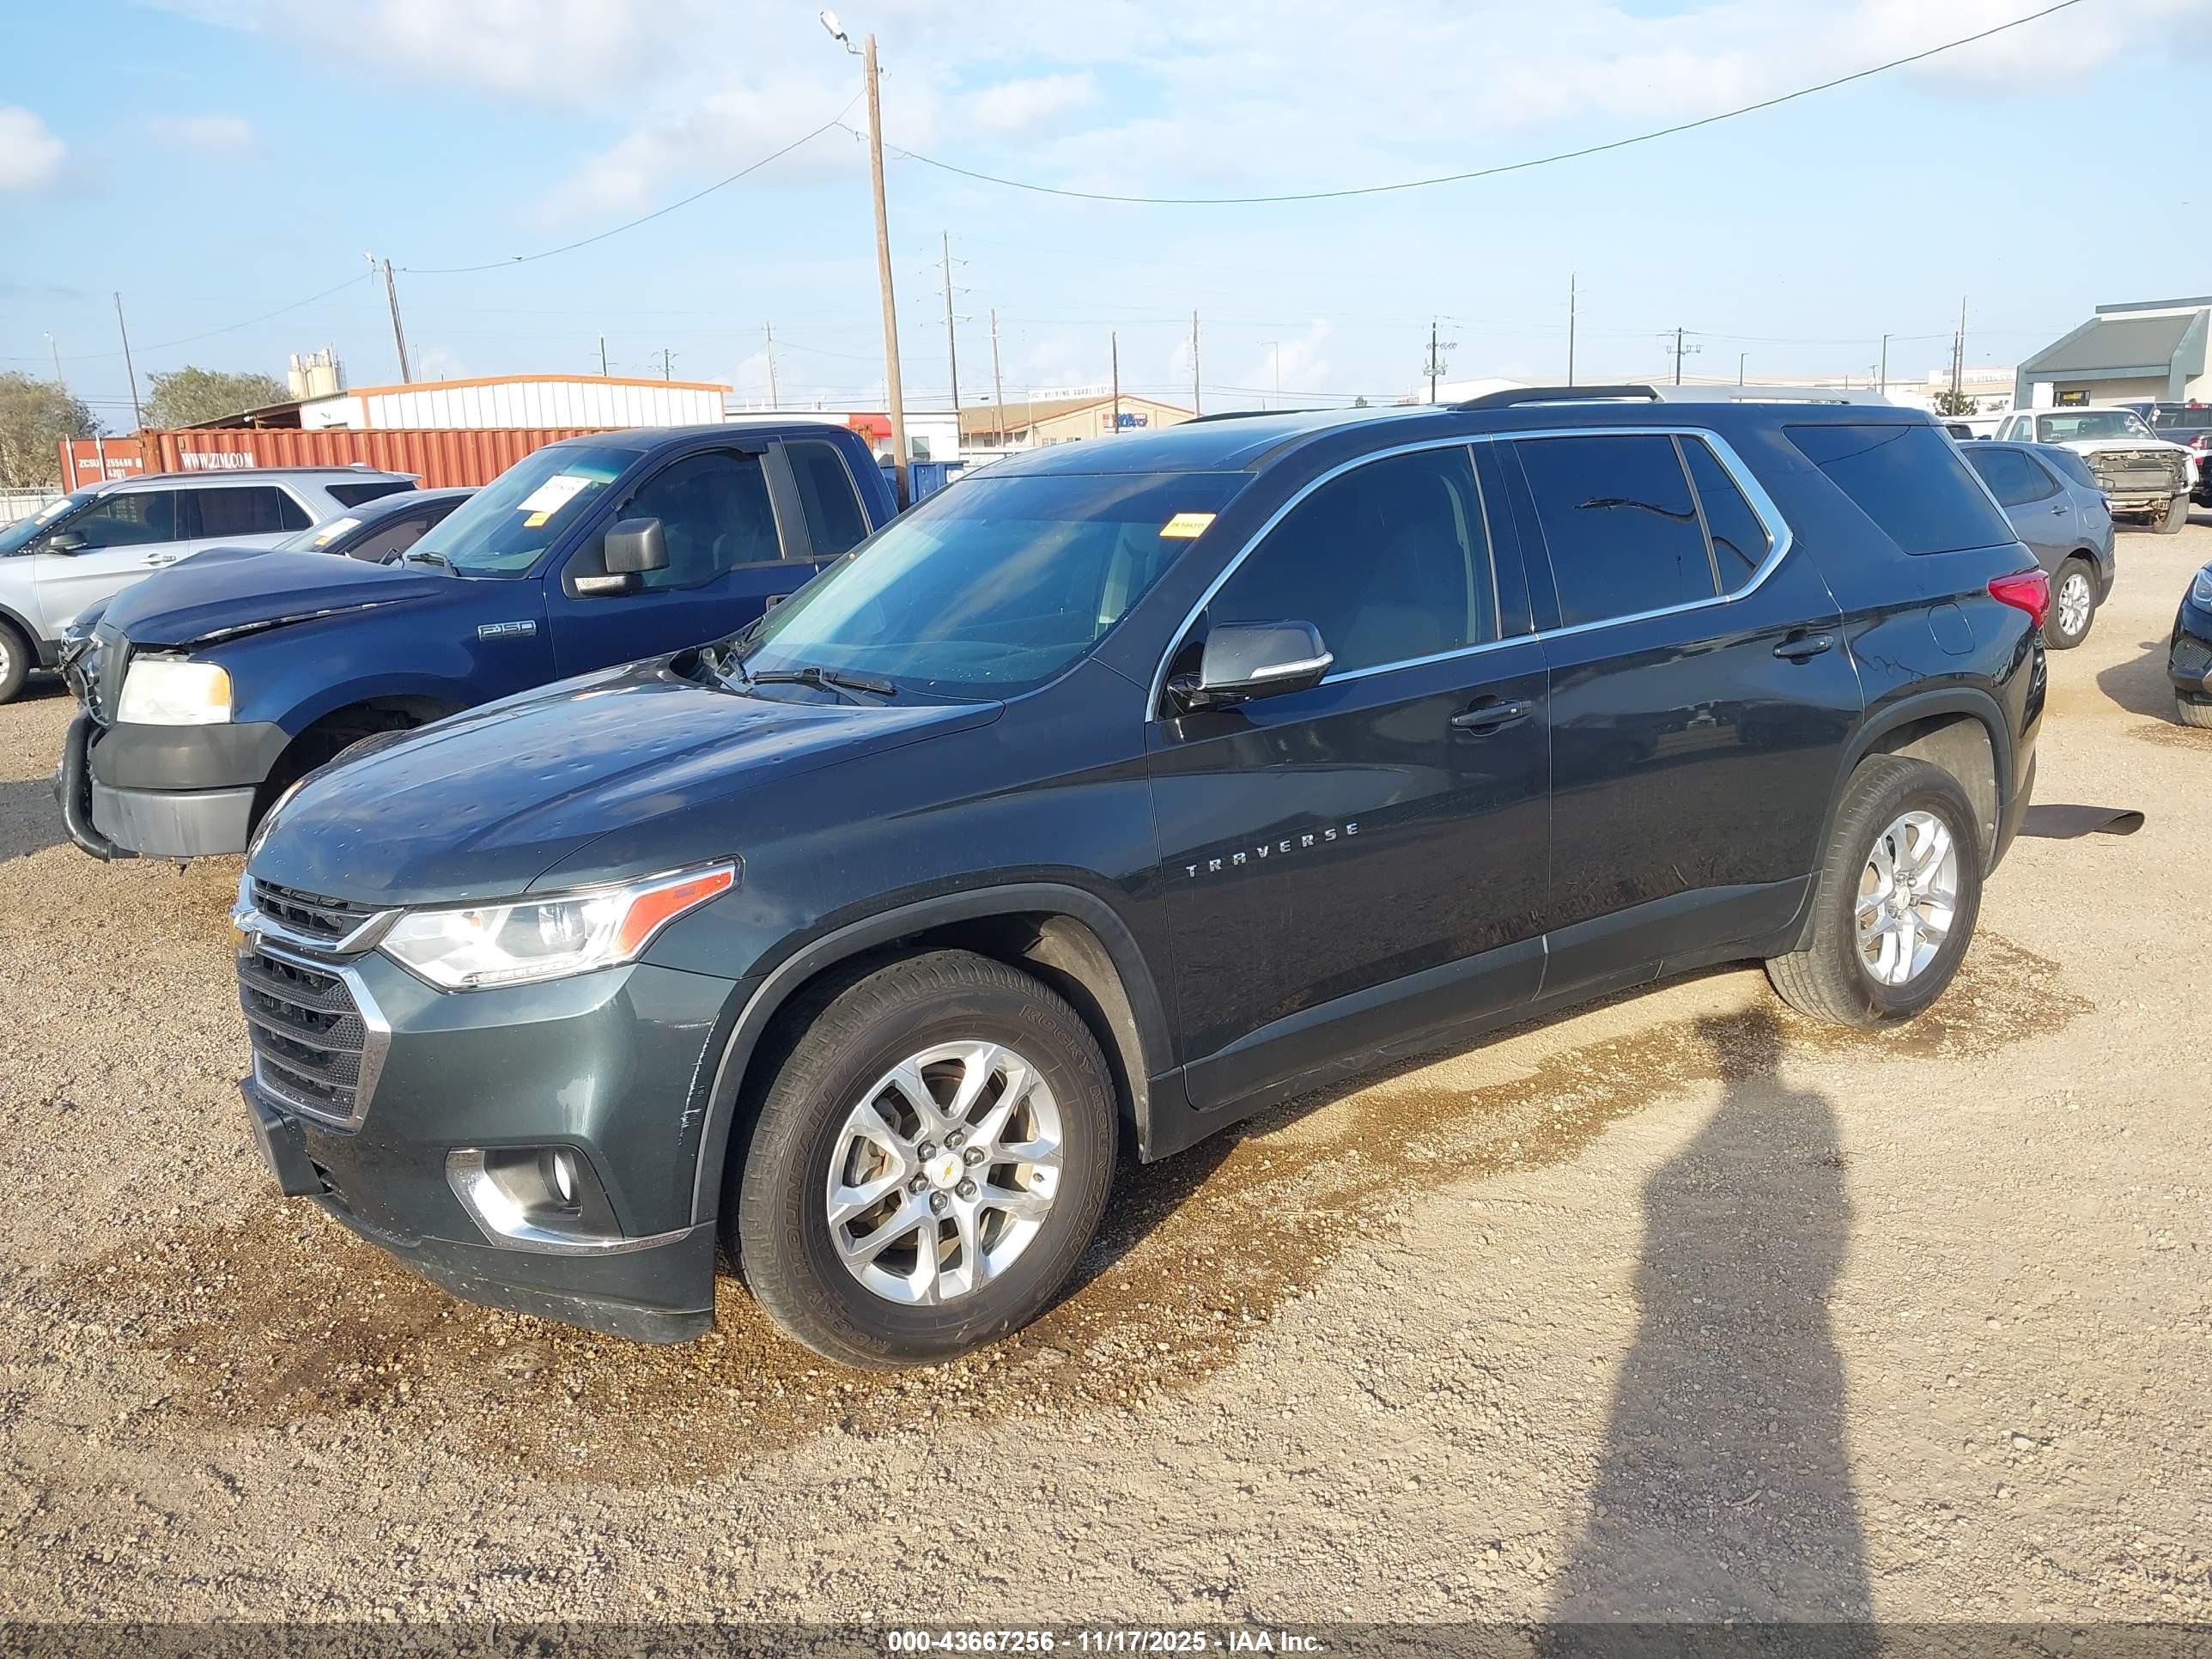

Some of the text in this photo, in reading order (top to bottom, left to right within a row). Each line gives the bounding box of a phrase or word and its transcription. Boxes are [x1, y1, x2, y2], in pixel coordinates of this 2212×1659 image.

[78, 459, 100, 469] ZCSU
[180, 452, 254, 469] WWW.ZIM.COM
[1186, 823, 1358, 878] TRAVERSE
[1019, 1004, 1096, 1073] ROCKY
[786, 1090, 834, 1277] MOUNTAIN
